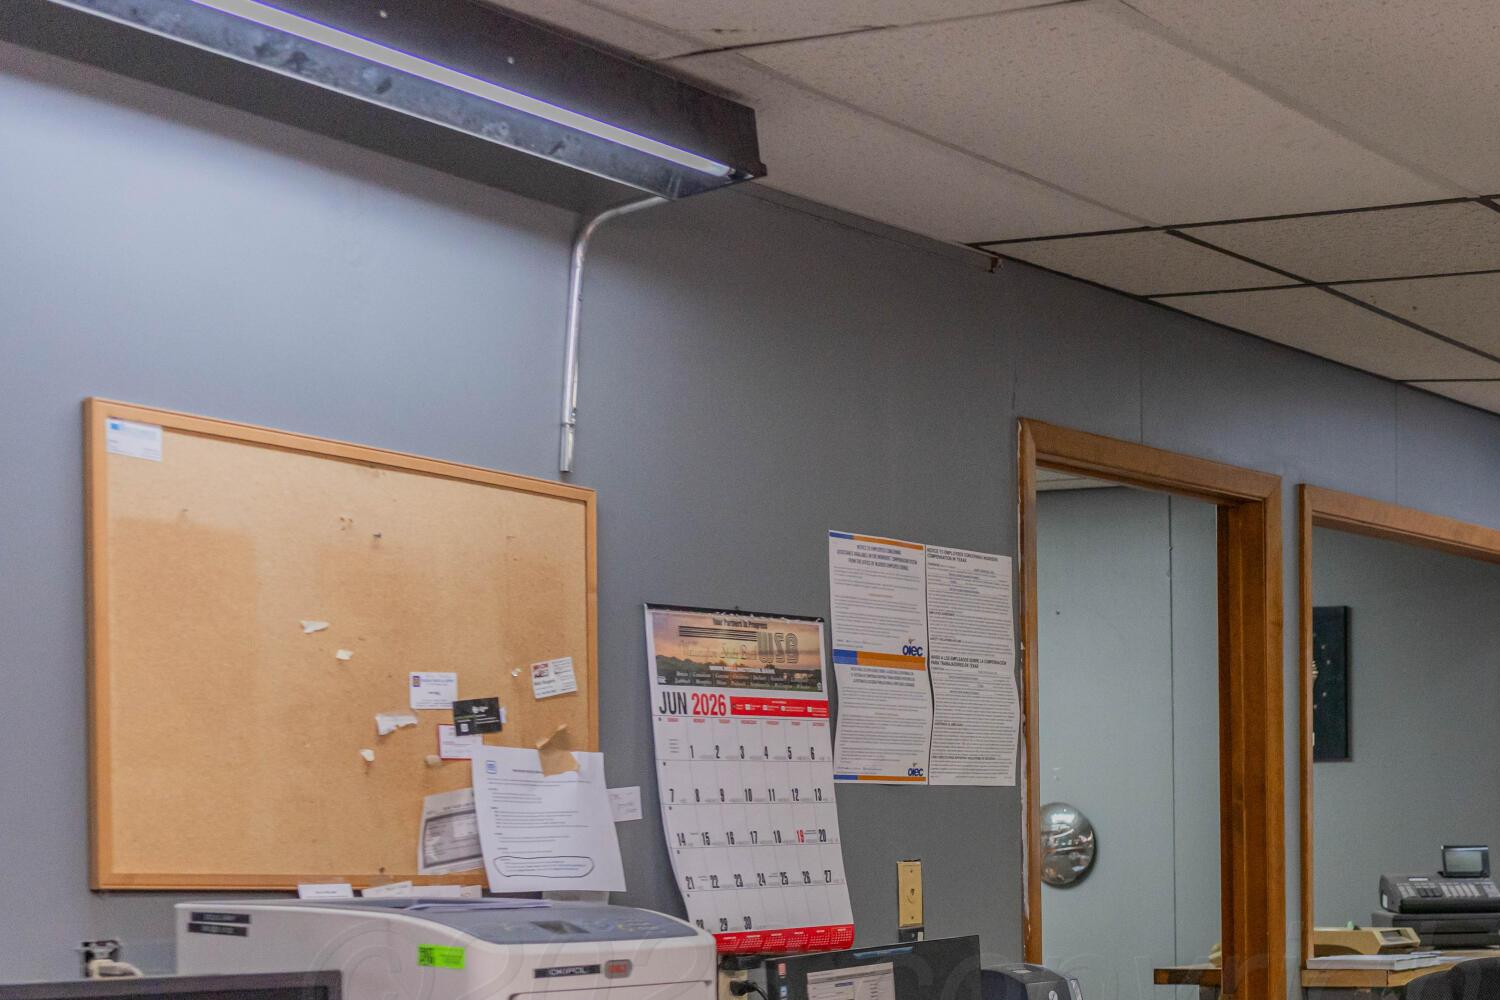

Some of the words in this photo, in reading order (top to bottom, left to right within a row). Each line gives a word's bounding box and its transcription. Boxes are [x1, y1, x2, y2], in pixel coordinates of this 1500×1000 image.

[659, 691, 688, 715] JUN
[692, 692, 726, 716] 2026
[690, 745, 694, 758] 1
[715, 745, 720, 758] 2
[740, 745, 745, 759] 3
[764, 746, 769, 759] 4
[788, 746, 792, 760] 5
[810, 747, 815, 760] 6
[670, 788, 674, 802] 7
[695, 788, 700, 802] 8
[720, 788, 725, 802] 9
[745, 788, 752, 802] 10
[769, 788, 776, 802] 11
[792, 788, 799, 802] 12
[815, 788, 822, 802] 13
[677, 833, 686, 846] 14
[701, 832, 710, 846] 15
[726, 832, 734, 845] 16
[750, 831, 758, 844] 17
[773, 830, 781, 843] 18
[797, 830, 804, 843] 19
[818, 829, 826, 842] 20
[686, 876, 694, 890] 21
[710, 875, 720, 888] 22
[734, 874, 743, 887] 23
[757, 873, 766, 886] 24
[780, 872, 788, 885] 25
[802, 871, 811, 884] 26
[824, 870, 832, 883] 27
[720, 918, 728, 932] 29
[744, 916, 752, 930] 30
